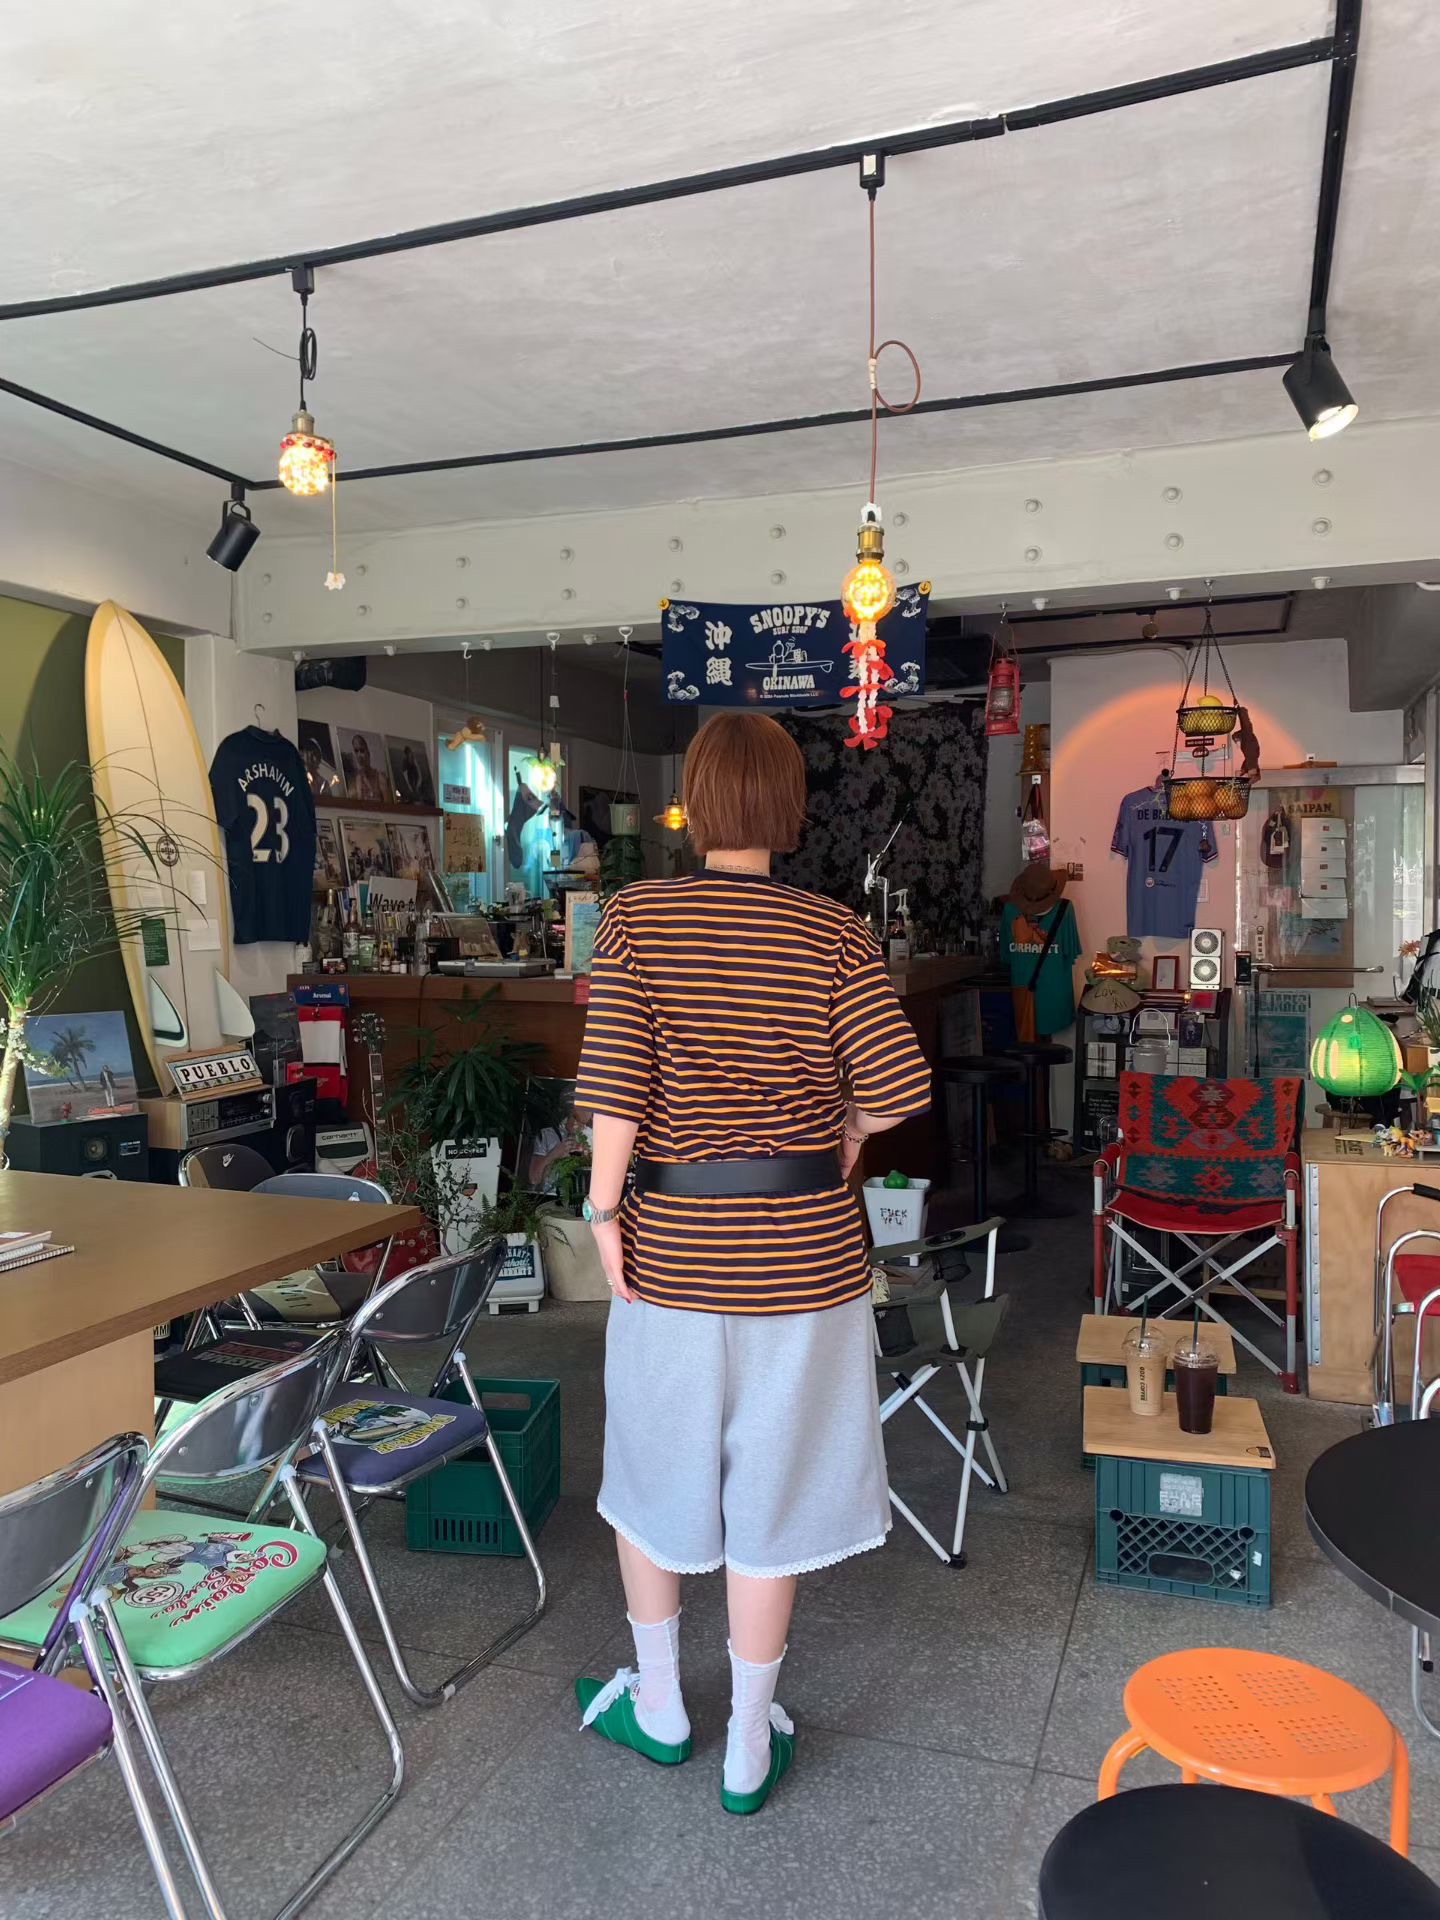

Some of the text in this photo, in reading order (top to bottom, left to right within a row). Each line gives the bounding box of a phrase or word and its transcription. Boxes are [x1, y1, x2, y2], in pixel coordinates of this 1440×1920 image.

[750, 605, 831, 634] SNOOPY'S
[772, 625, 808, 635] SURF SHOP
[762, 674, 815, 690] OKINAWA
[237, 763, 295, 797] ARSHAVIN
[1137, 809, 1149, 821] DE
[1288, 802, 1332, 814] SAIPAN
[247, 793, 289, 863] 23
[1143, 826, 1184, 872] 17
[180, 1057, 252, 1084] PUEBLO
[880, 1208, 907, 1218] FUCK
